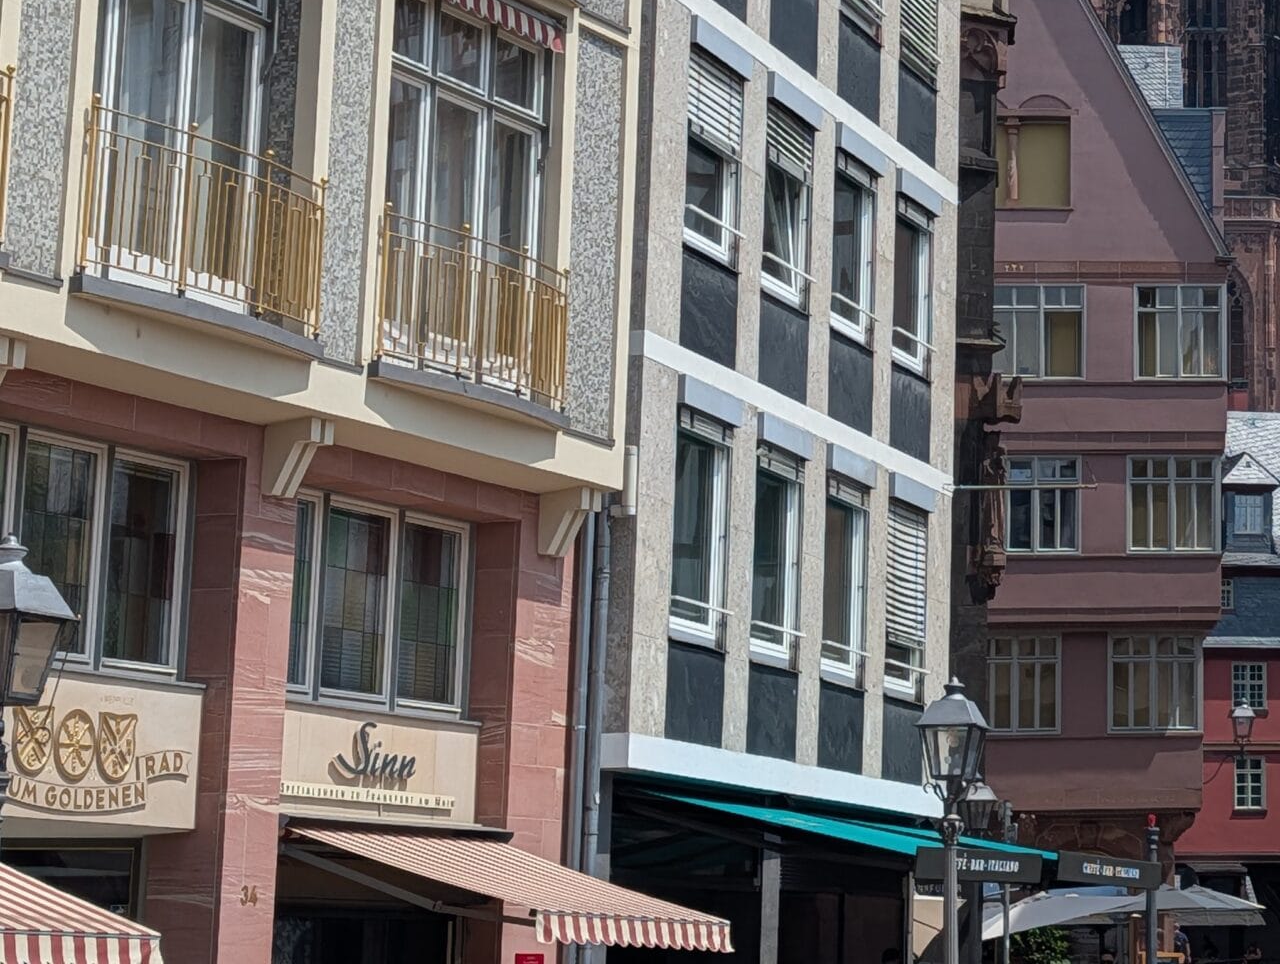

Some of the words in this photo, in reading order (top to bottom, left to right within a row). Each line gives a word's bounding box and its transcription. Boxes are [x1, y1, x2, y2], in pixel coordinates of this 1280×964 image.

[144, 752, 184, 777] RAD
[336, 721, 416, 779] Sinn
[8, 774, 37, 804] UM
[44, 785, 146, 810] GOLDENEN
[240, 884, 258, 907] 34
